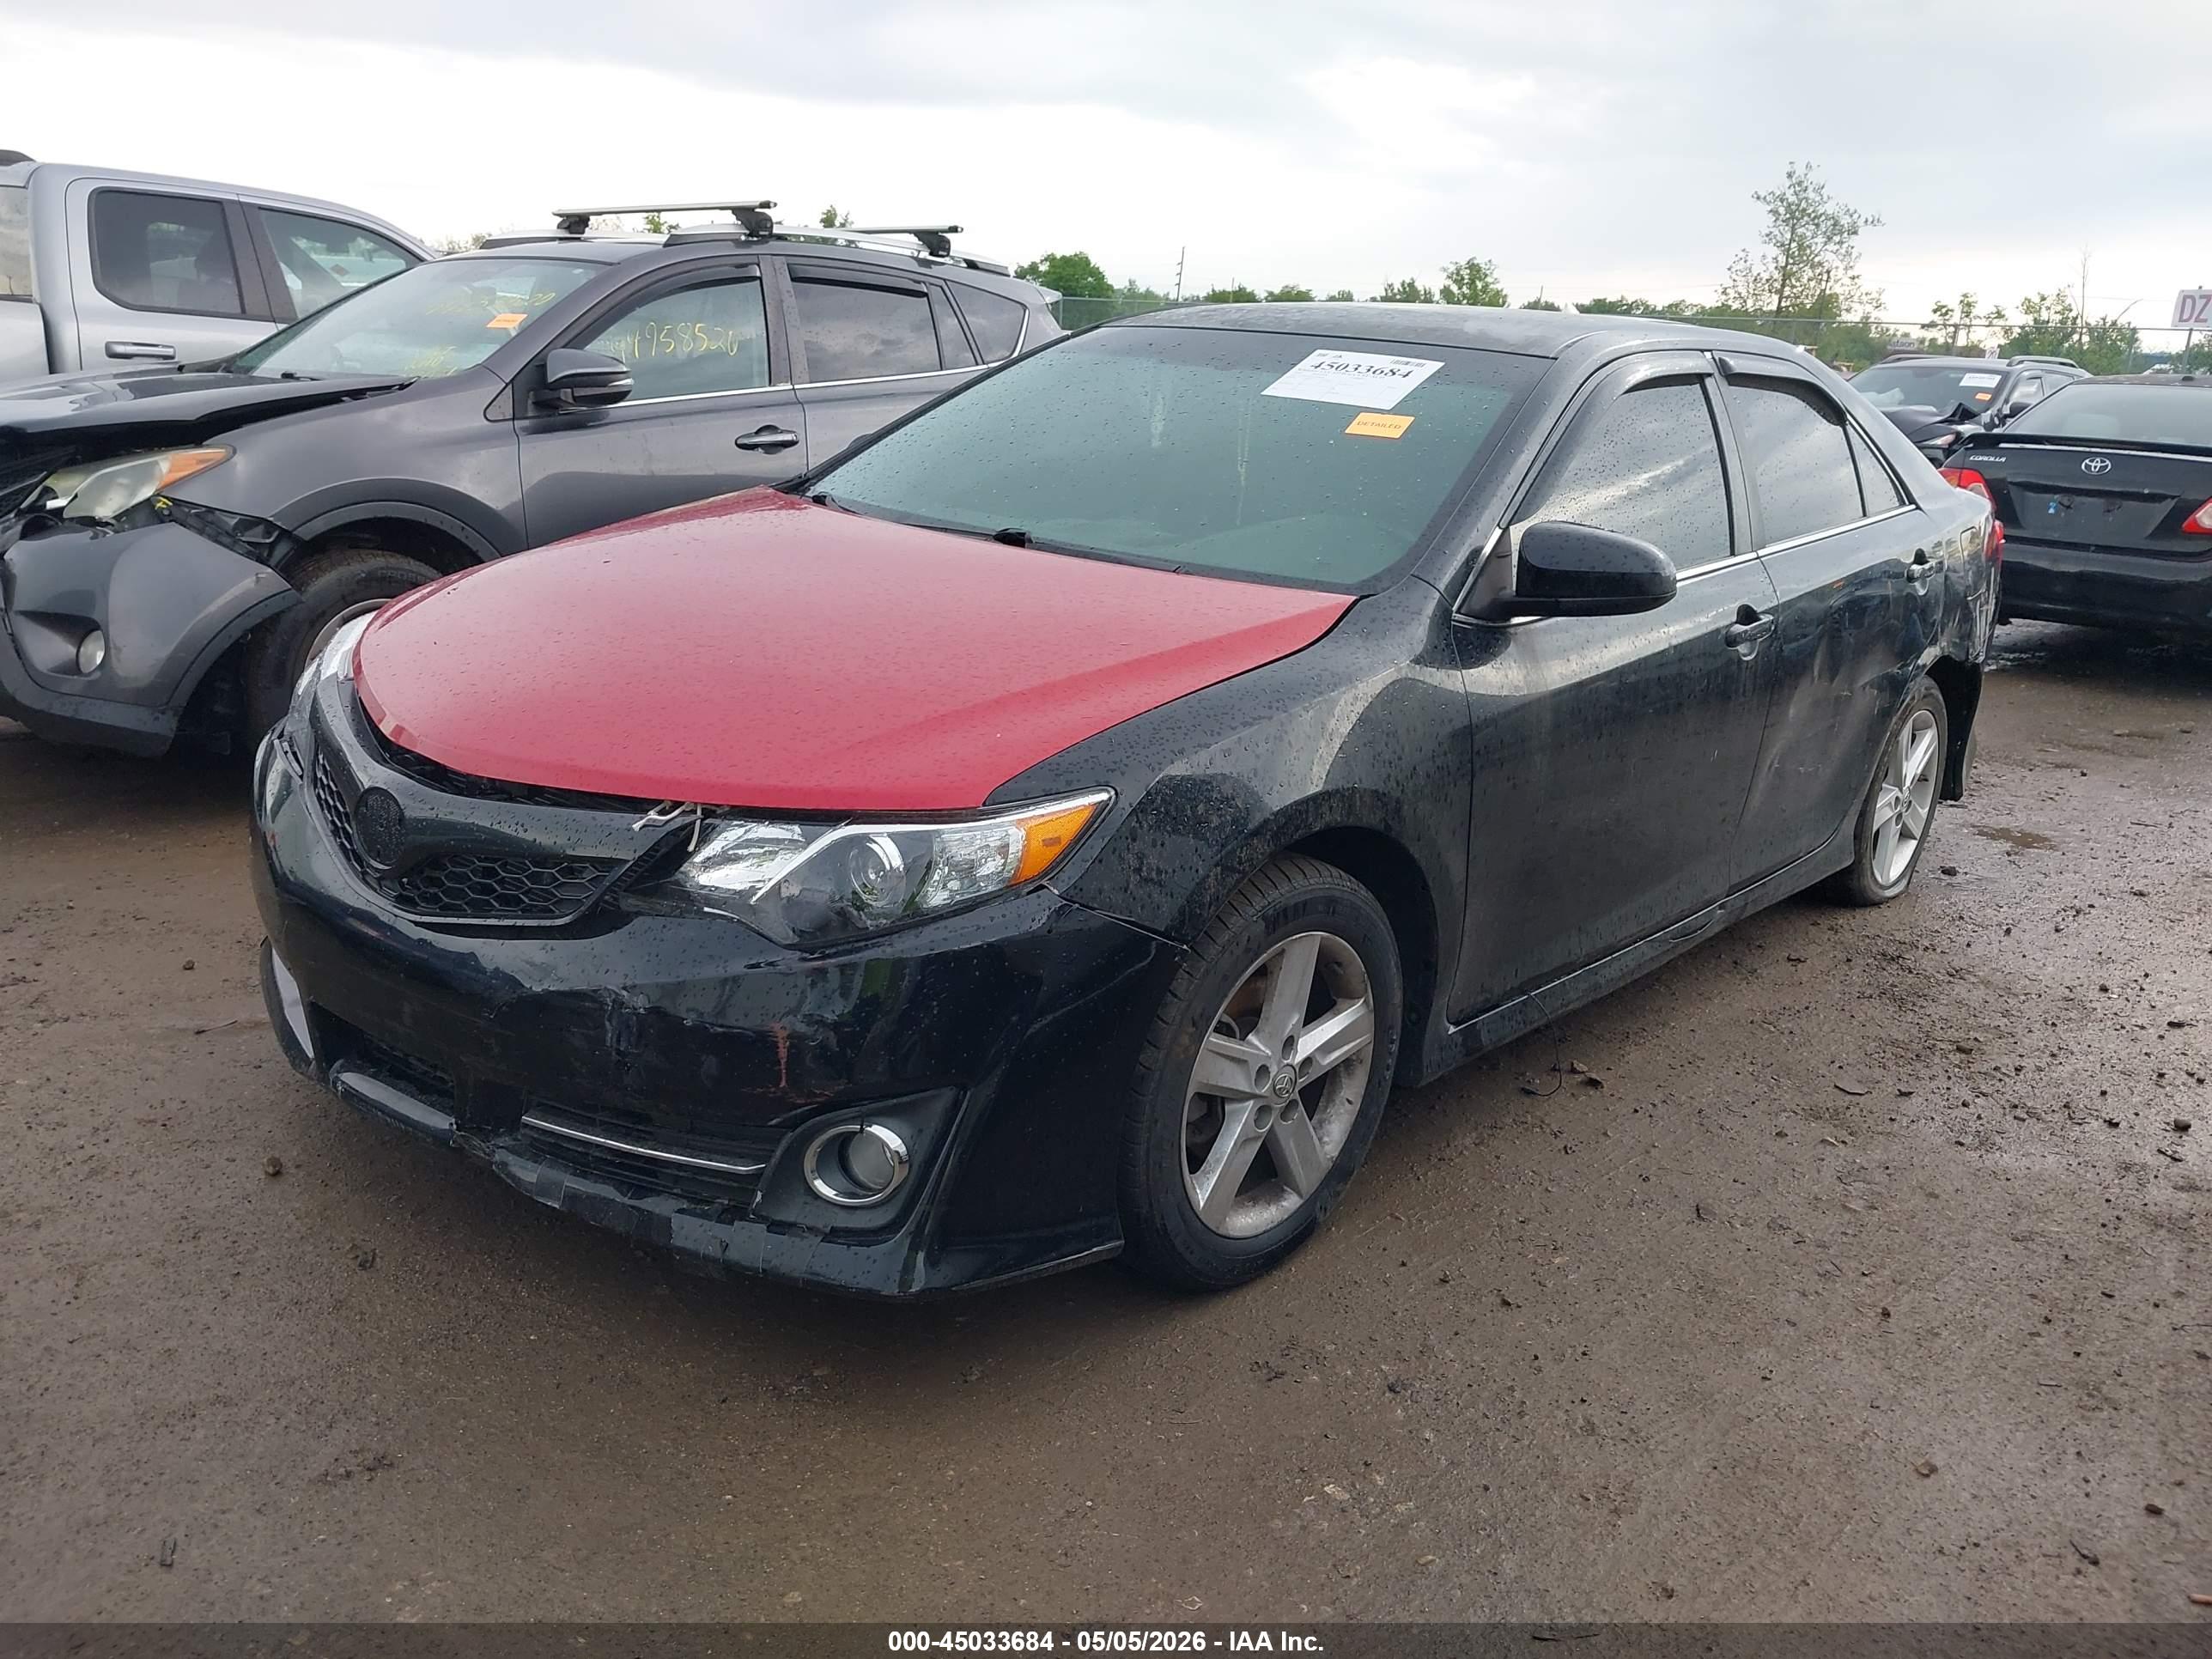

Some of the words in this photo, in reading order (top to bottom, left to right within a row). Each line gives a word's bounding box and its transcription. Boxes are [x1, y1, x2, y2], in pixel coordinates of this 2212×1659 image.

[2178, 295, 2212, 323] DZ
[1310, 360, 1413, 379] 45033684
[1357, 420, 1401, 429] DETAILED
